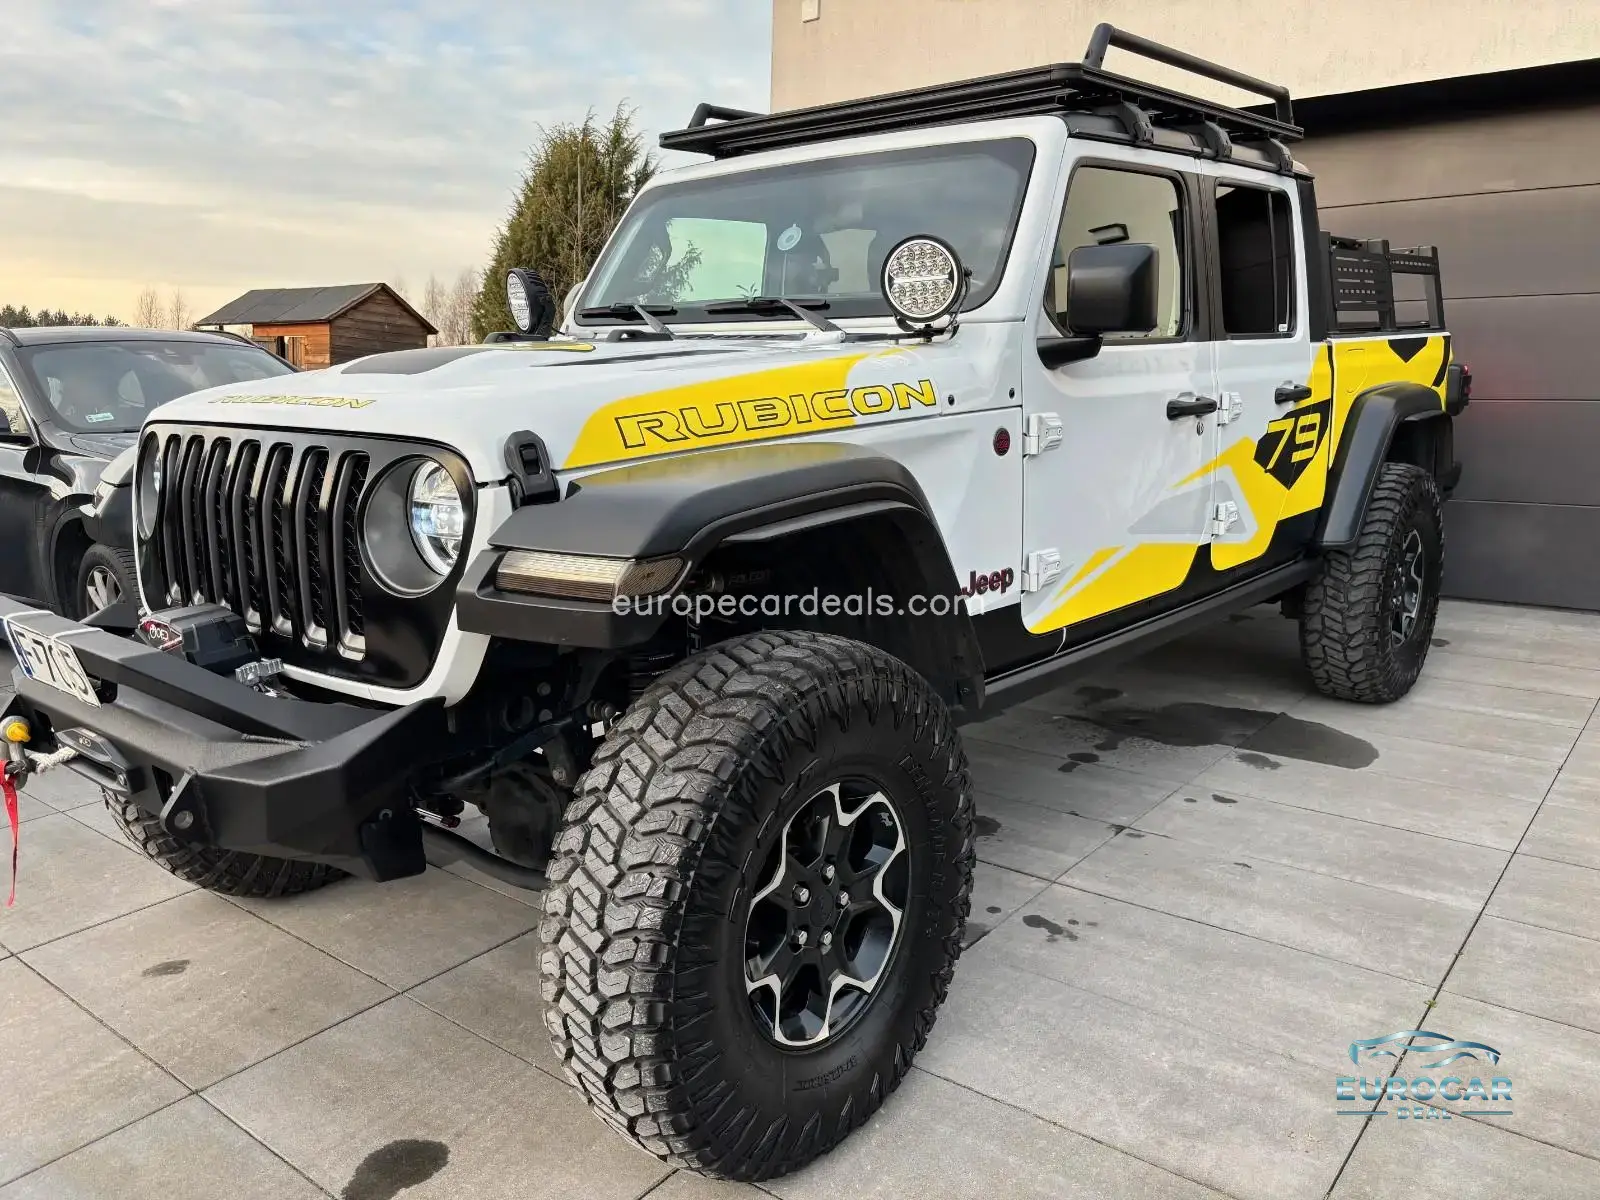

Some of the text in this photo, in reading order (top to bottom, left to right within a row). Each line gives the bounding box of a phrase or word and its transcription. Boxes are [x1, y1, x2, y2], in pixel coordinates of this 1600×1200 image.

[208, 393, 376, 409] RUBICON
[614, 379, 937, 449] RUBICON
[1268, 412, 1321, 471] 79
[961, 567, 1014, 598] Jeep
